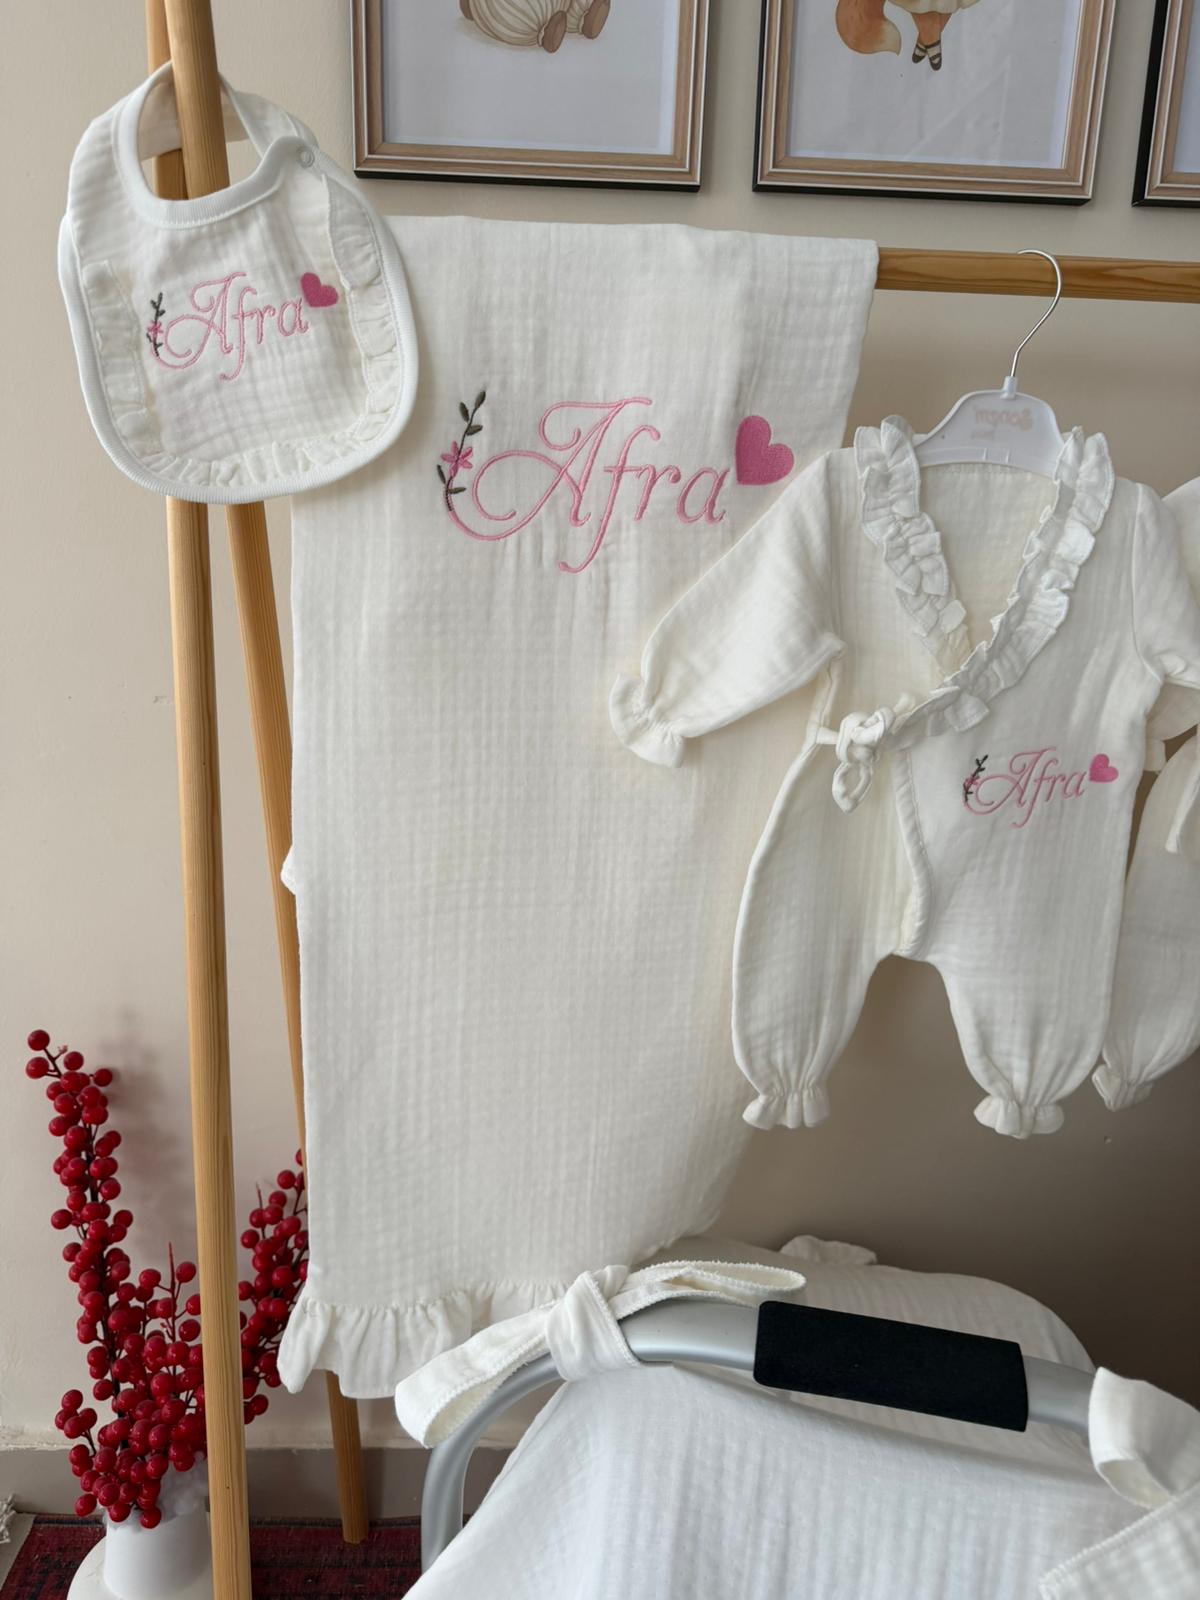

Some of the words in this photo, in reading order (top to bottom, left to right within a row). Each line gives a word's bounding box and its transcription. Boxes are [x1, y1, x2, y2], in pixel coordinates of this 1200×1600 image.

[150, 272, 310, 382] Afra
[446, 397, 731, 574] Afra
[963, 745, 1087, 829] Afra
